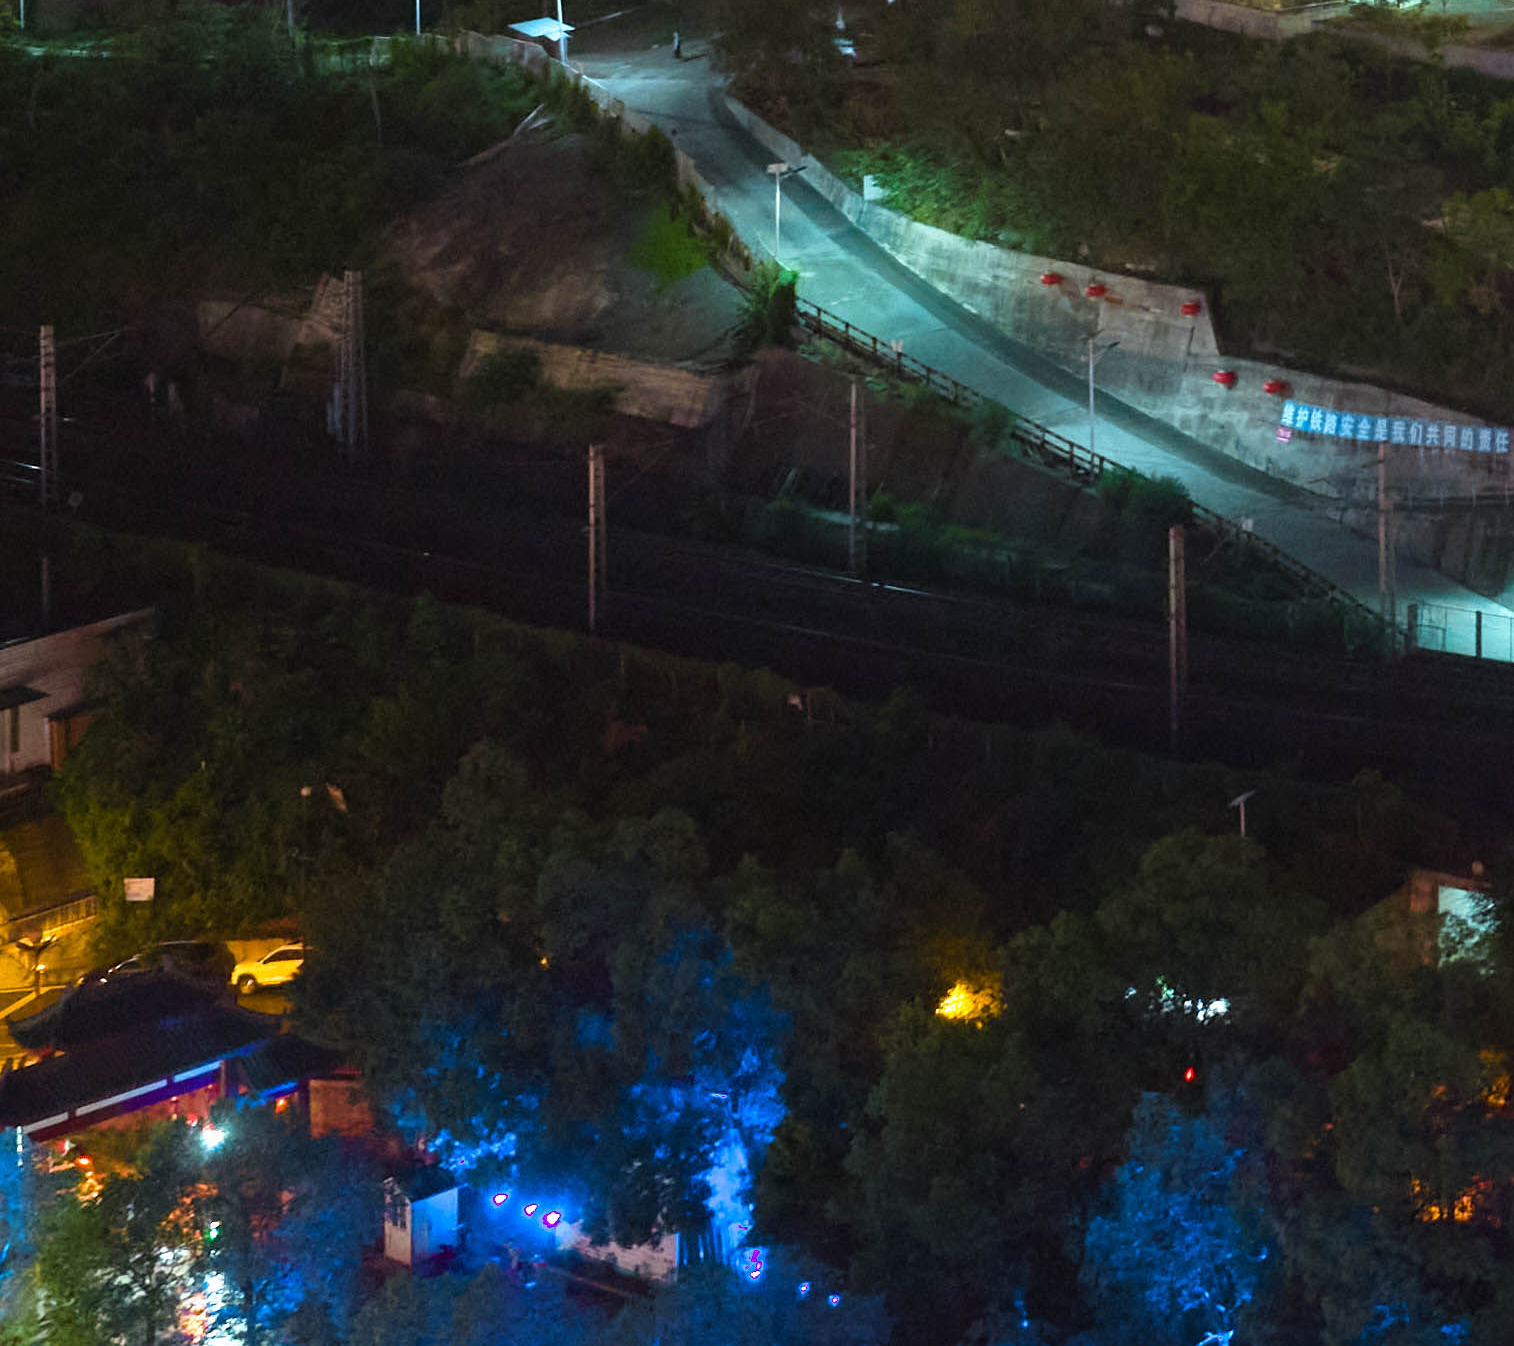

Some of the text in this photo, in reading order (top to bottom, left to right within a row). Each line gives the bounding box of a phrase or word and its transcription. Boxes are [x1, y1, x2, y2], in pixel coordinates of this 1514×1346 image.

[1281, 402, 1510, 453] 维护铁路安全是我们共同的责任
